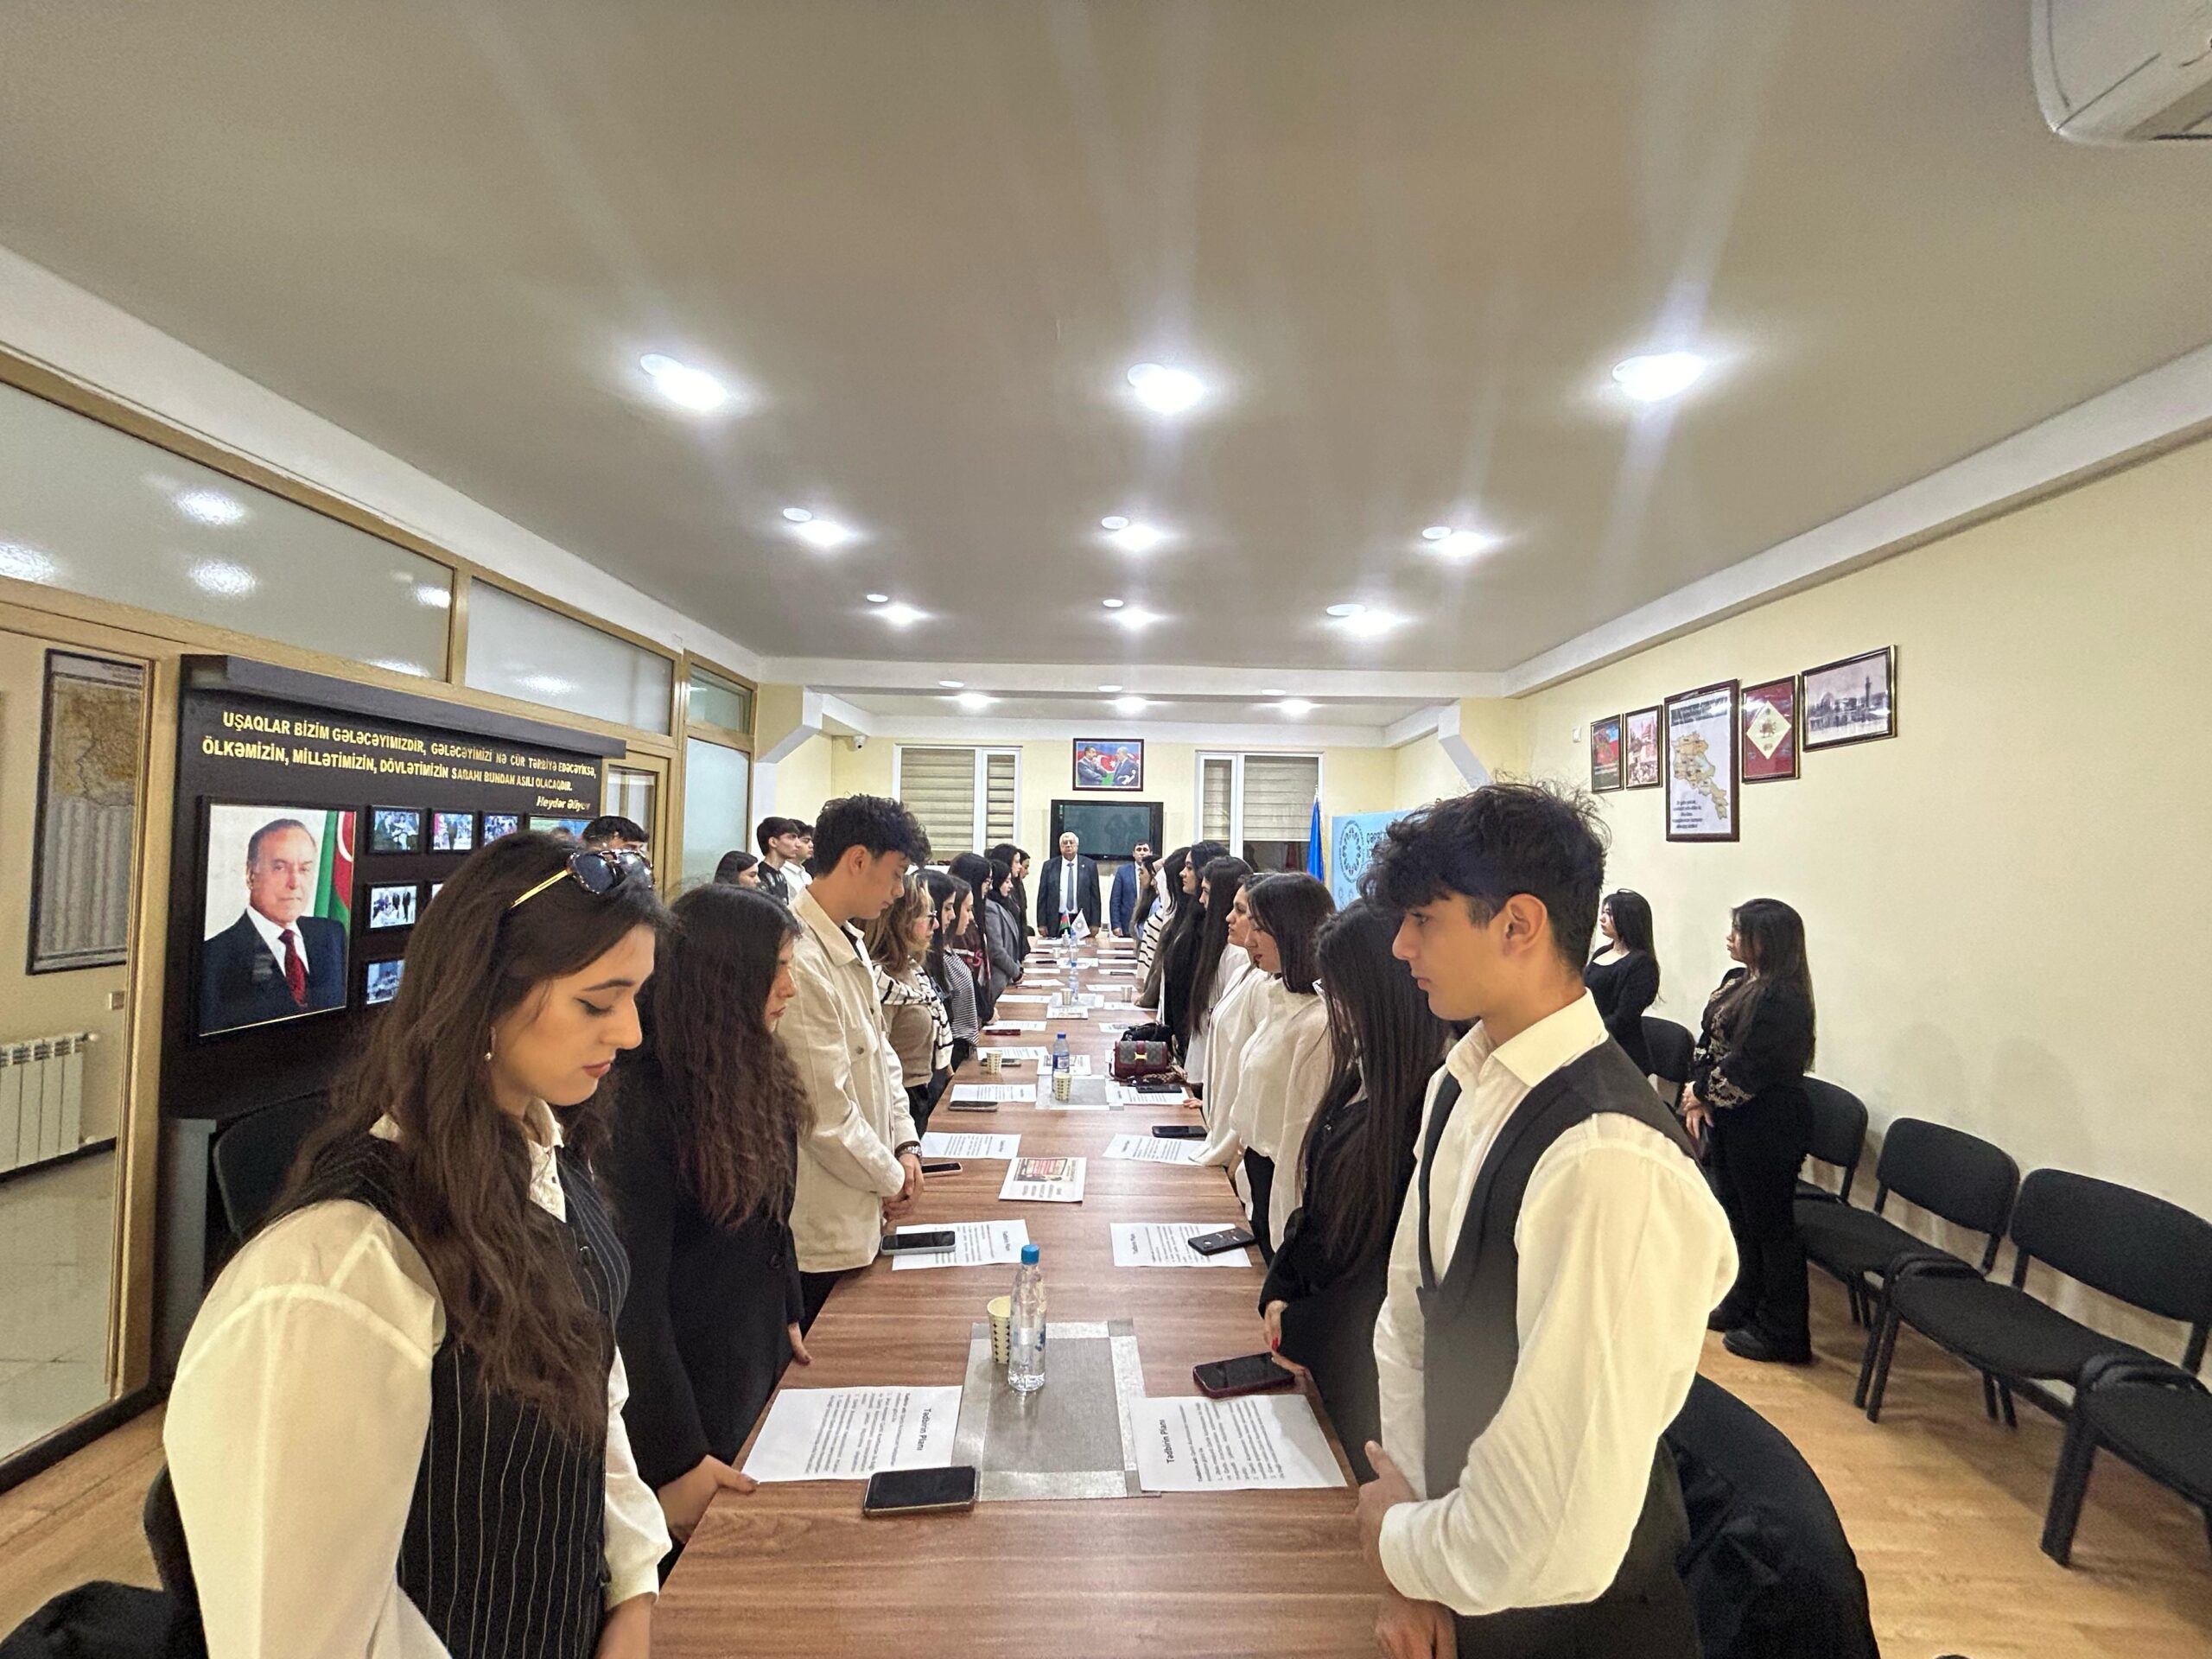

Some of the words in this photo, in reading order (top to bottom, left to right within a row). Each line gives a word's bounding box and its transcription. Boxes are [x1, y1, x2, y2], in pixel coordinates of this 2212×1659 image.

[223, 711, 290, 734] UŞAQLAR
[294, 720, 329, 740] BİZİM
[332, 728, 426, 756] GƏLƏCƏYİMİZDİR,
[430, 743, 493, 762] GƏLƏCƏYİMİZİ
[495, 753, 507, 764] NƏ
[510, 753, 525, 766] CÜR
[528, 758, 557, 772] TƏRBİYƏ
[202, 735, 289, 766] ÖLKƏMİZİN,
[292, 747, 377, 774] MİLLƏTİMİZİN,
[379, 759, 448, 779] DÖVLƏTİMİZİN
[451, 767, 482, 782] SABAHI
[484, 772, 515, 785] BUNDAN
[516, 775, 534, 787] ASILI
[536, 778, 572, 791] OLACAQDIR.
[536, 796, 566, 810] Heydər
[919, 1408, 931, 1433] Tədbirin
[1162, 1436, 1175, 1464] Tədbirin
